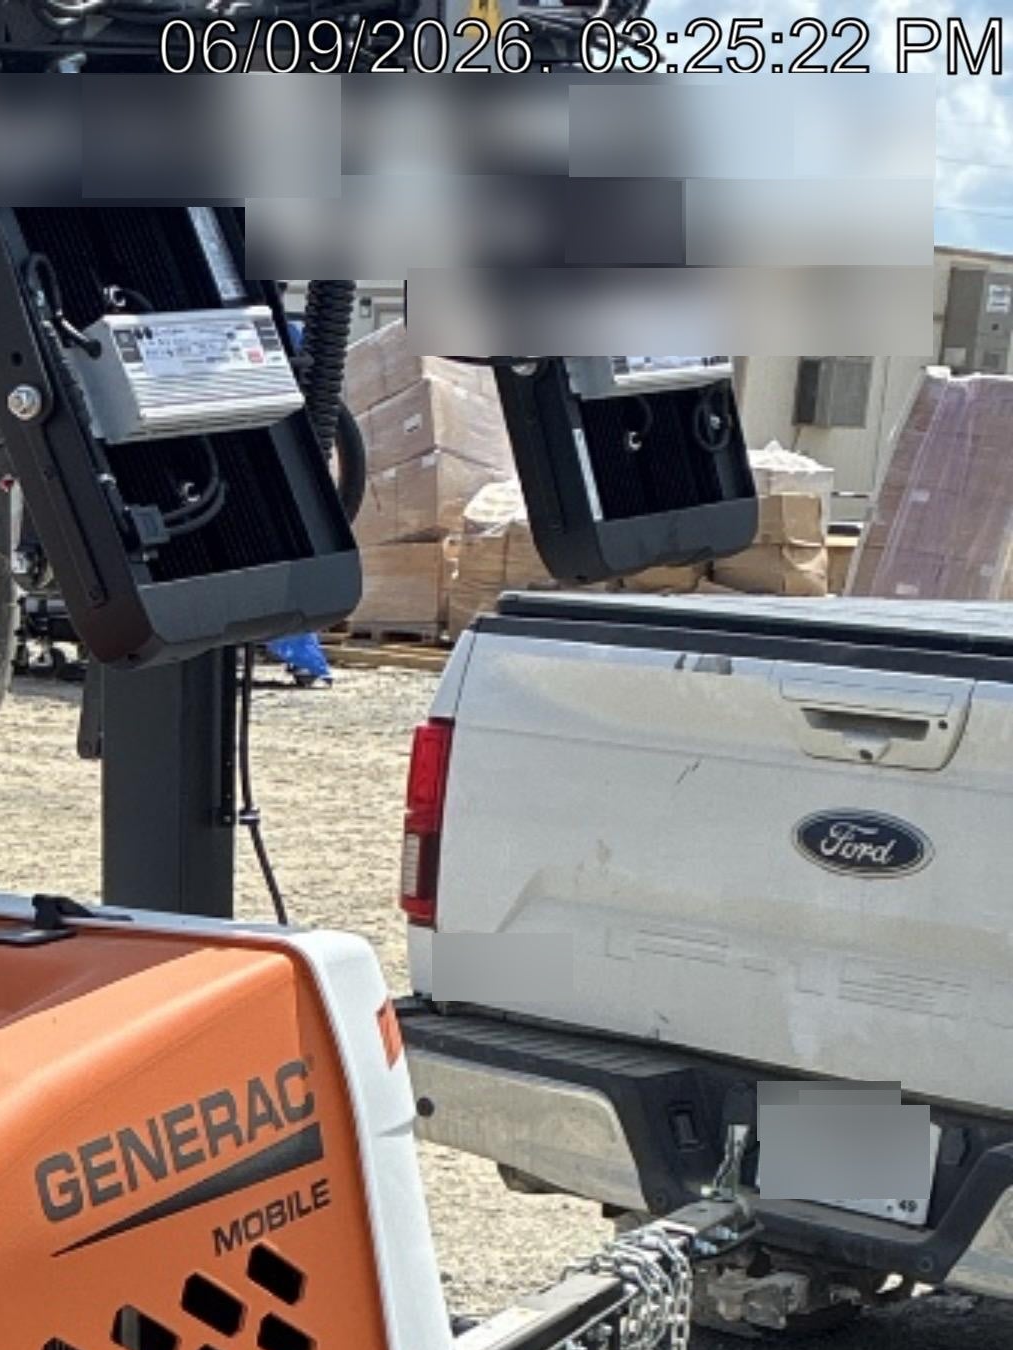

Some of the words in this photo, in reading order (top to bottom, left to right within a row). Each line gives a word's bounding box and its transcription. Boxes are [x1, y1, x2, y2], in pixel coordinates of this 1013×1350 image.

[820, 821, 897, 864] Ford
[34, 1058, 316, 1222] GENERAC
[211, 1178, 332, 1257] MOBILE
